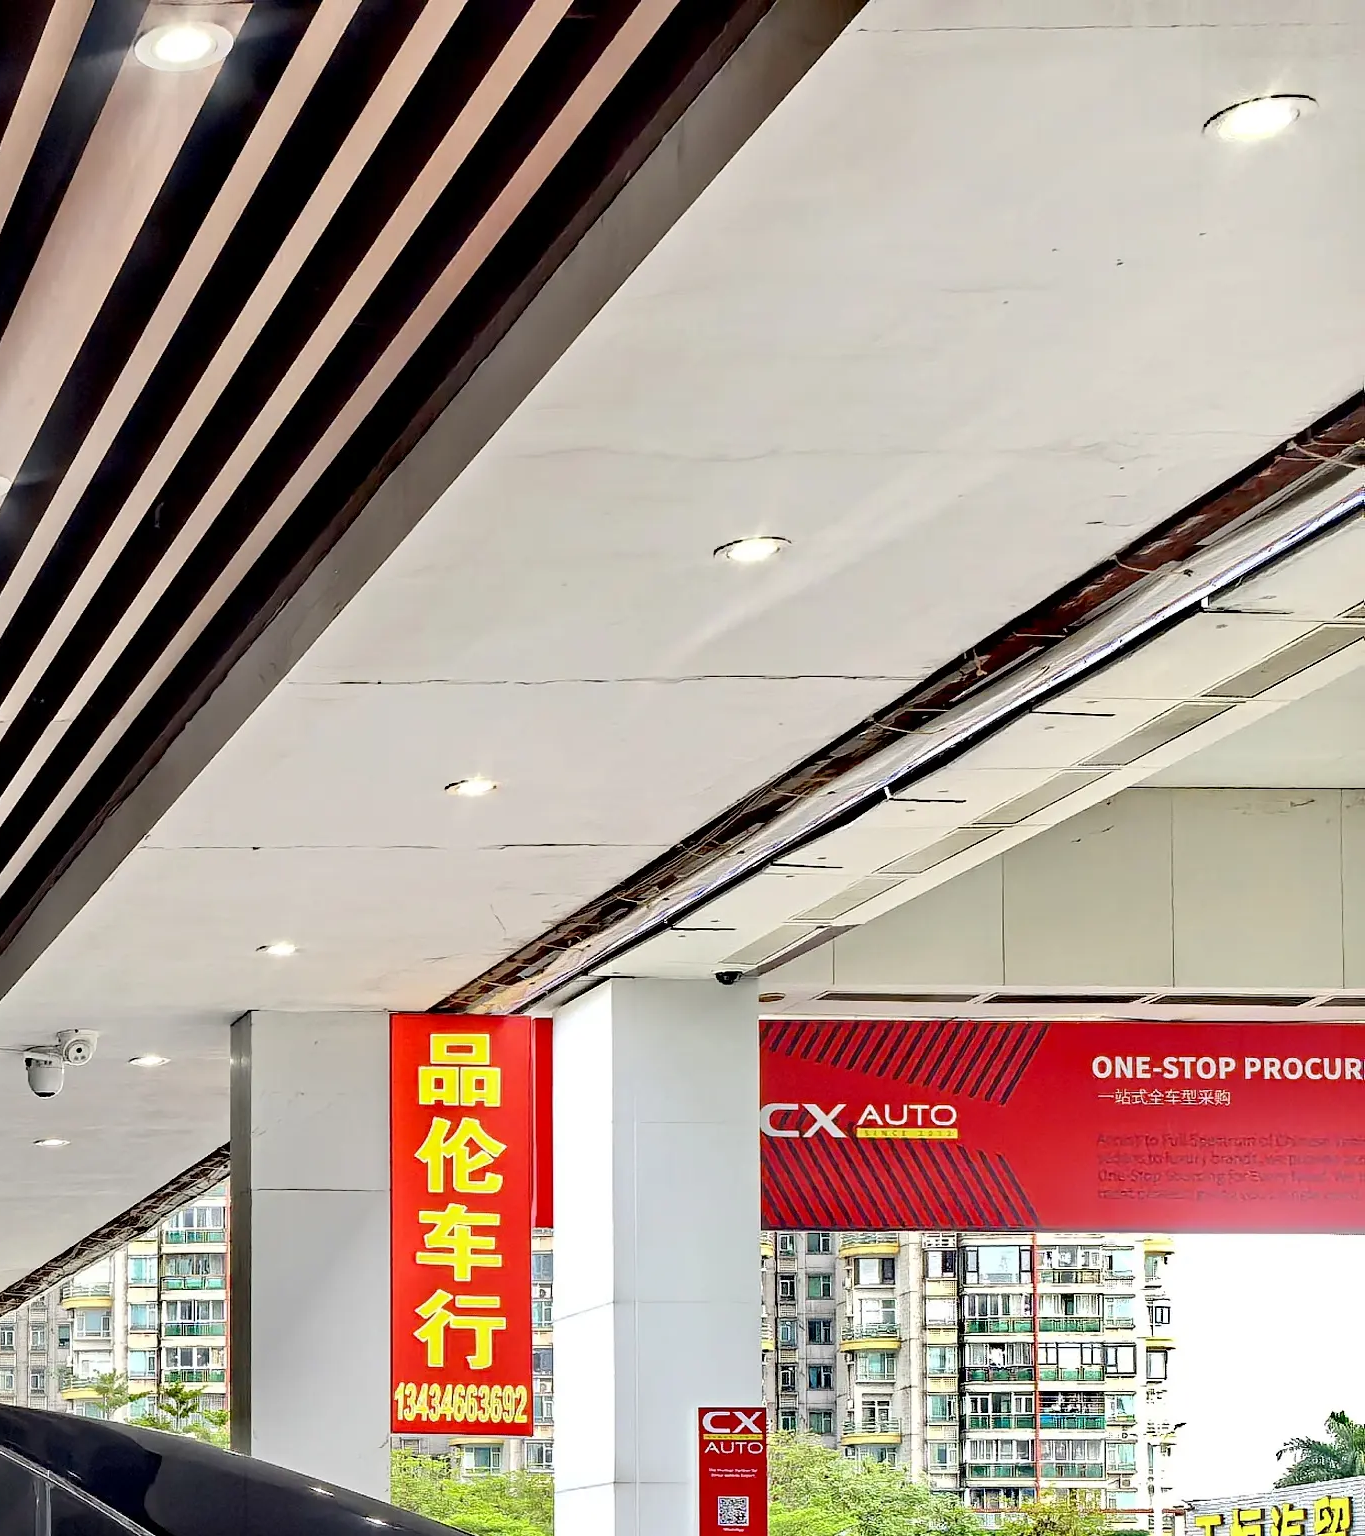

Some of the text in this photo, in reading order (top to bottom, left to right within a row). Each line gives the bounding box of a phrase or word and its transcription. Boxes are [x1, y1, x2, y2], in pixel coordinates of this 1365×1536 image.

[1092, 1055, 1365, 1081] ONE-STOP PROCUR
[1097, 1088, 1231, 1106] 一站式全车型采购
[760, 1103, 957, 1138] CX AUTO
[413, 1033, 508, 1370] 品伦车行
[394, 1382, 528, 1424] 13434663692
[702, 1411, 763, 1434] CX
[704, 1441, 764, 1454] AUTO
